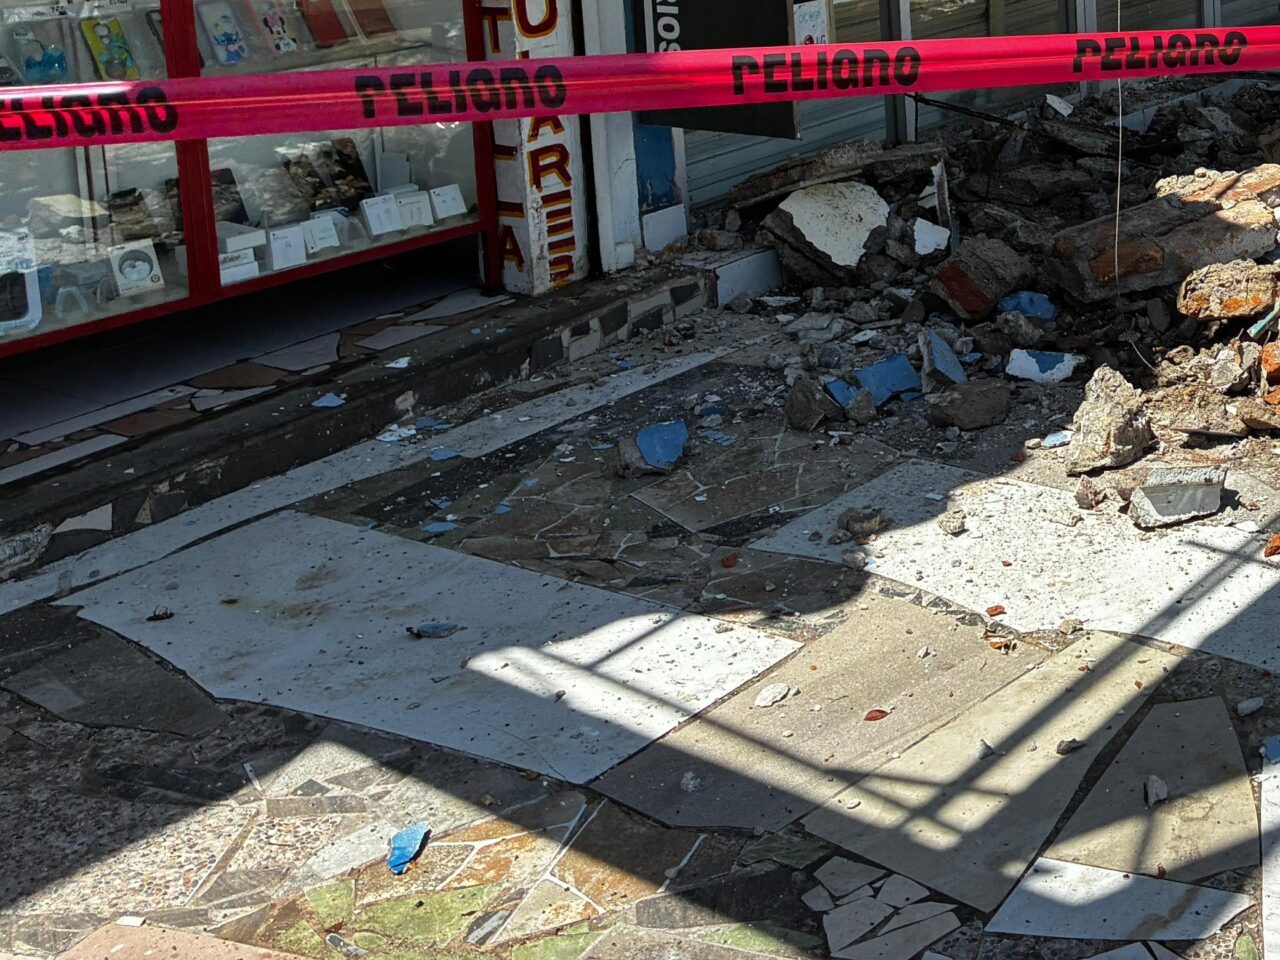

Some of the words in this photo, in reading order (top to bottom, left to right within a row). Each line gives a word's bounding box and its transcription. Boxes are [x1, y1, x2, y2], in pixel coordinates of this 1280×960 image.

[731, 45, 922, 95] PELIGRO
[1073, 31, 1248, 73] PELIGRO
[0, 86, 178, 139] ELIGRO
[355, 63, 567, 119] PELIGRO
